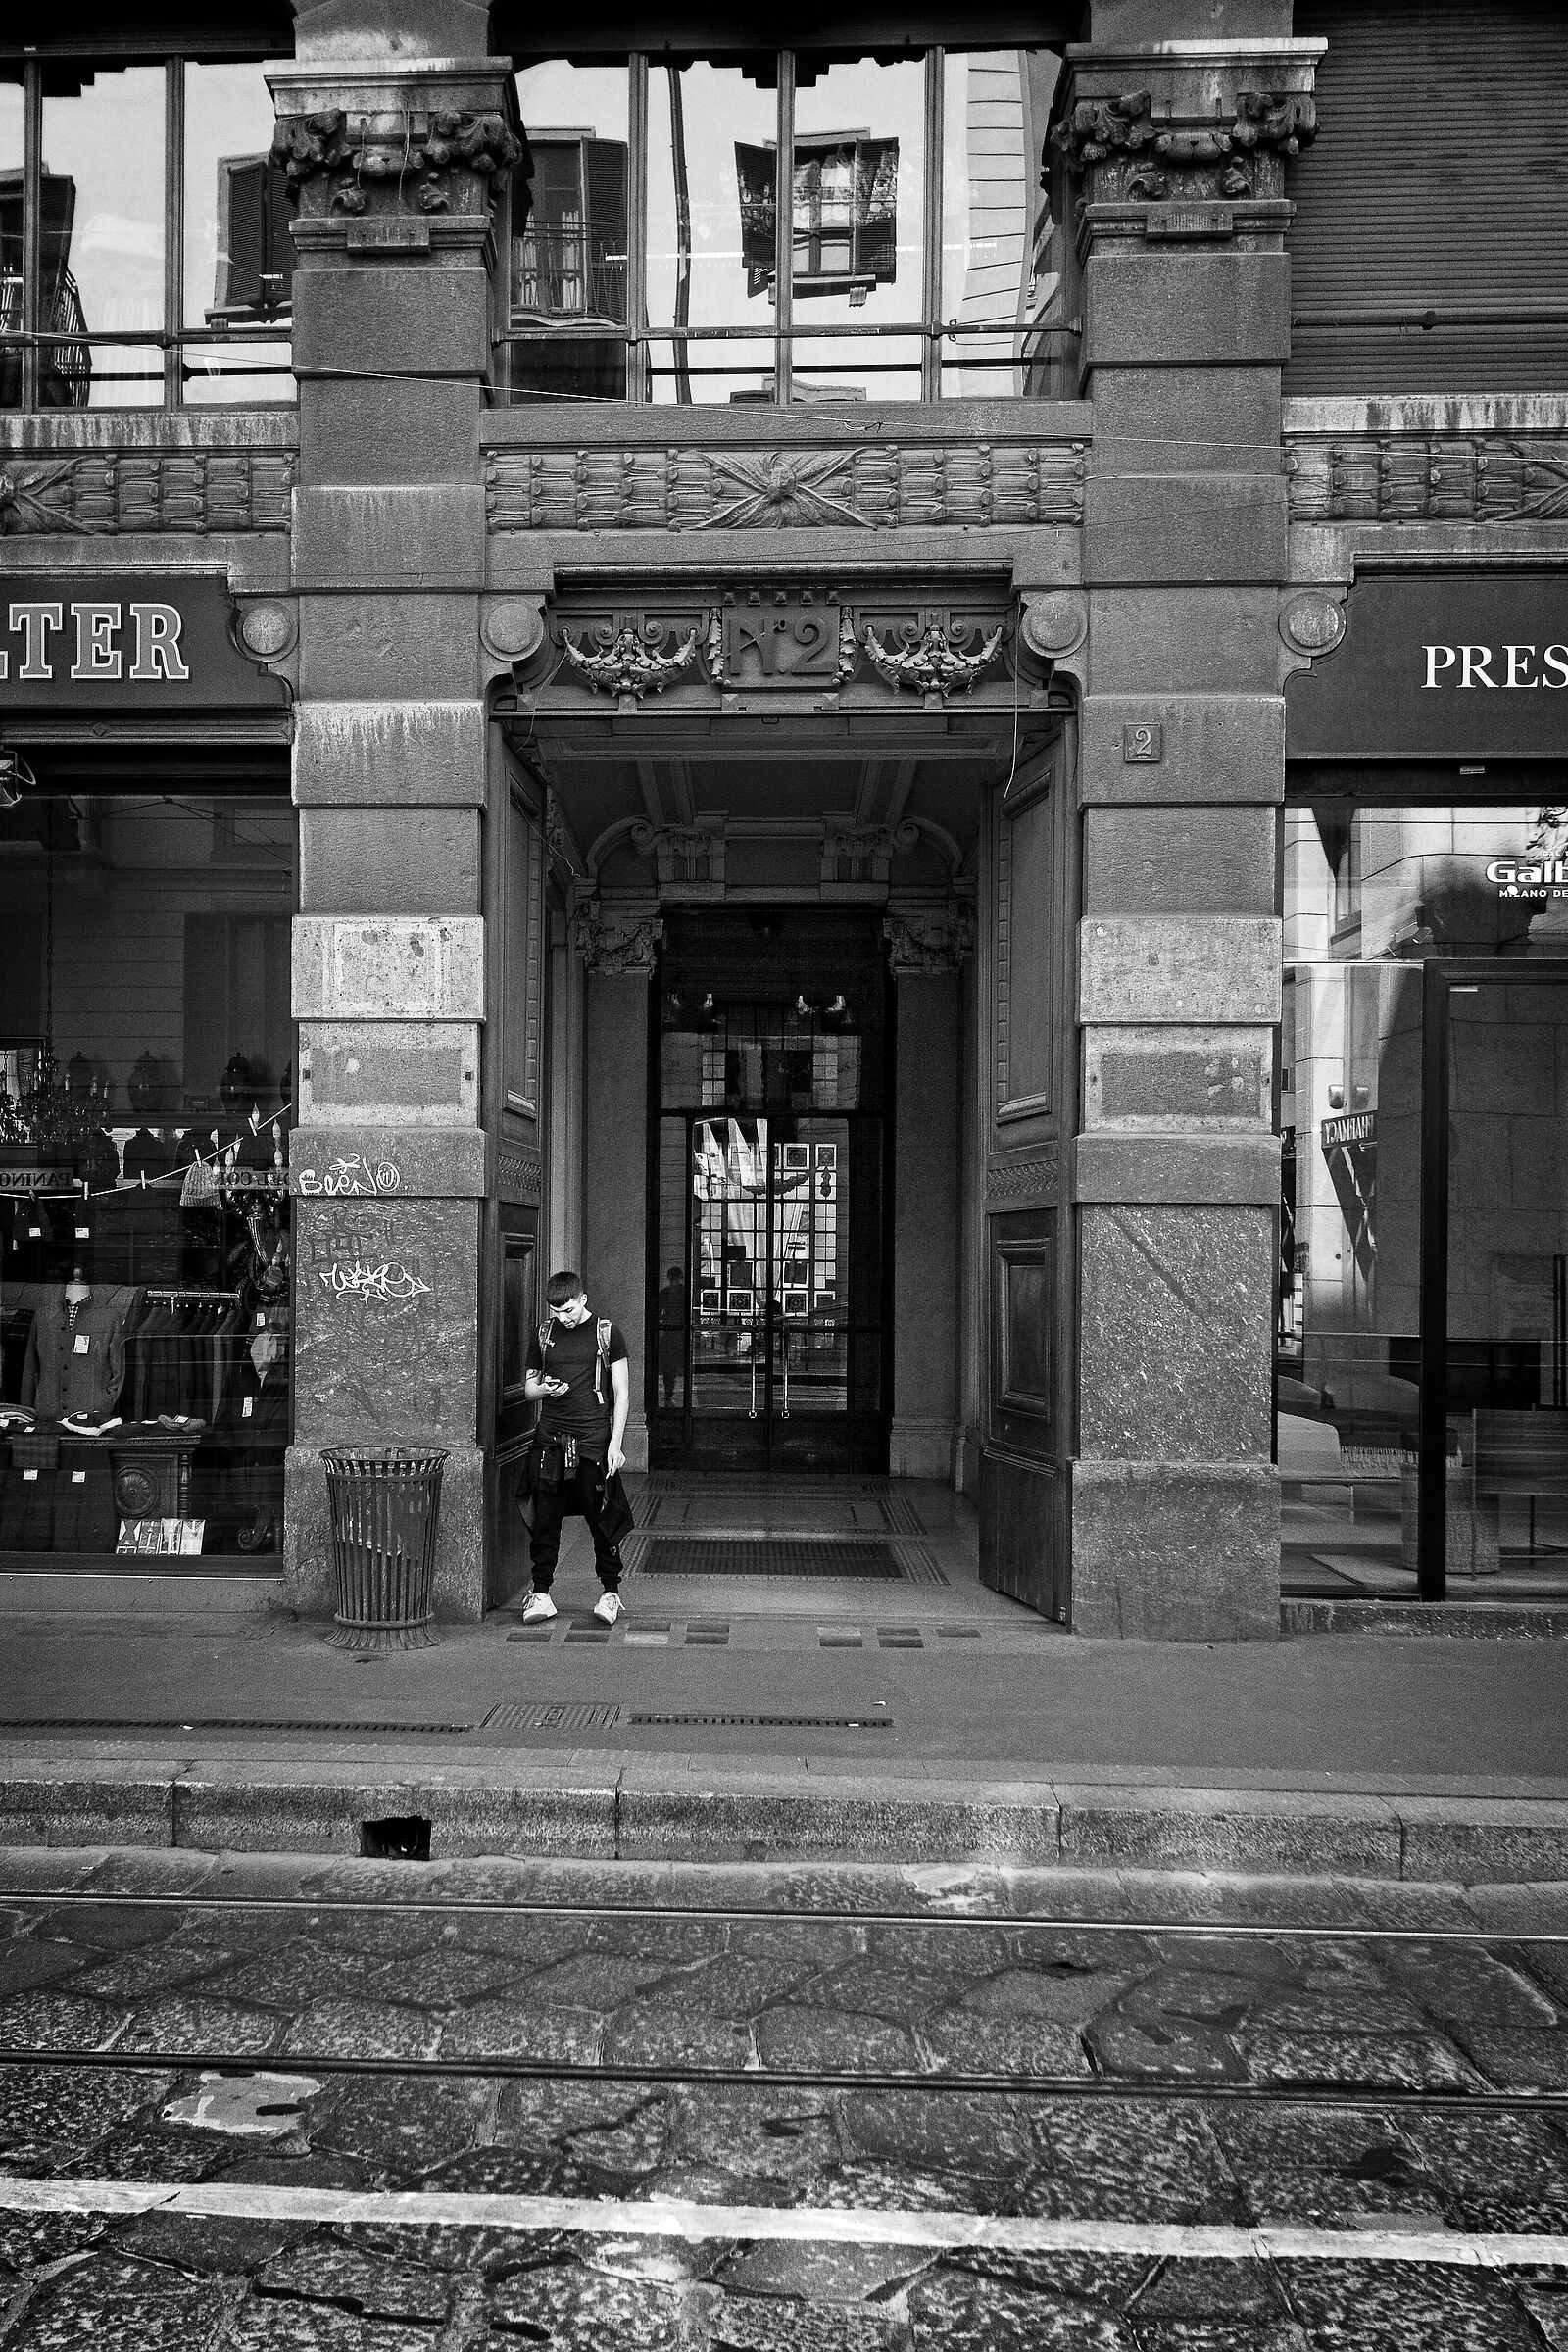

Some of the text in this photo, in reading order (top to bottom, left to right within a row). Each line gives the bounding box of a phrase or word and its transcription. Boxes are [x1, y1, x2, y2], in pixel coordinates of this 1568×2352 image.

[0, 603, 189, 679] TER
[794, 614, 833, 674] 2
[1421, 644, 1568, 688] PRES
[1135, 727, 1152, 756] 2
